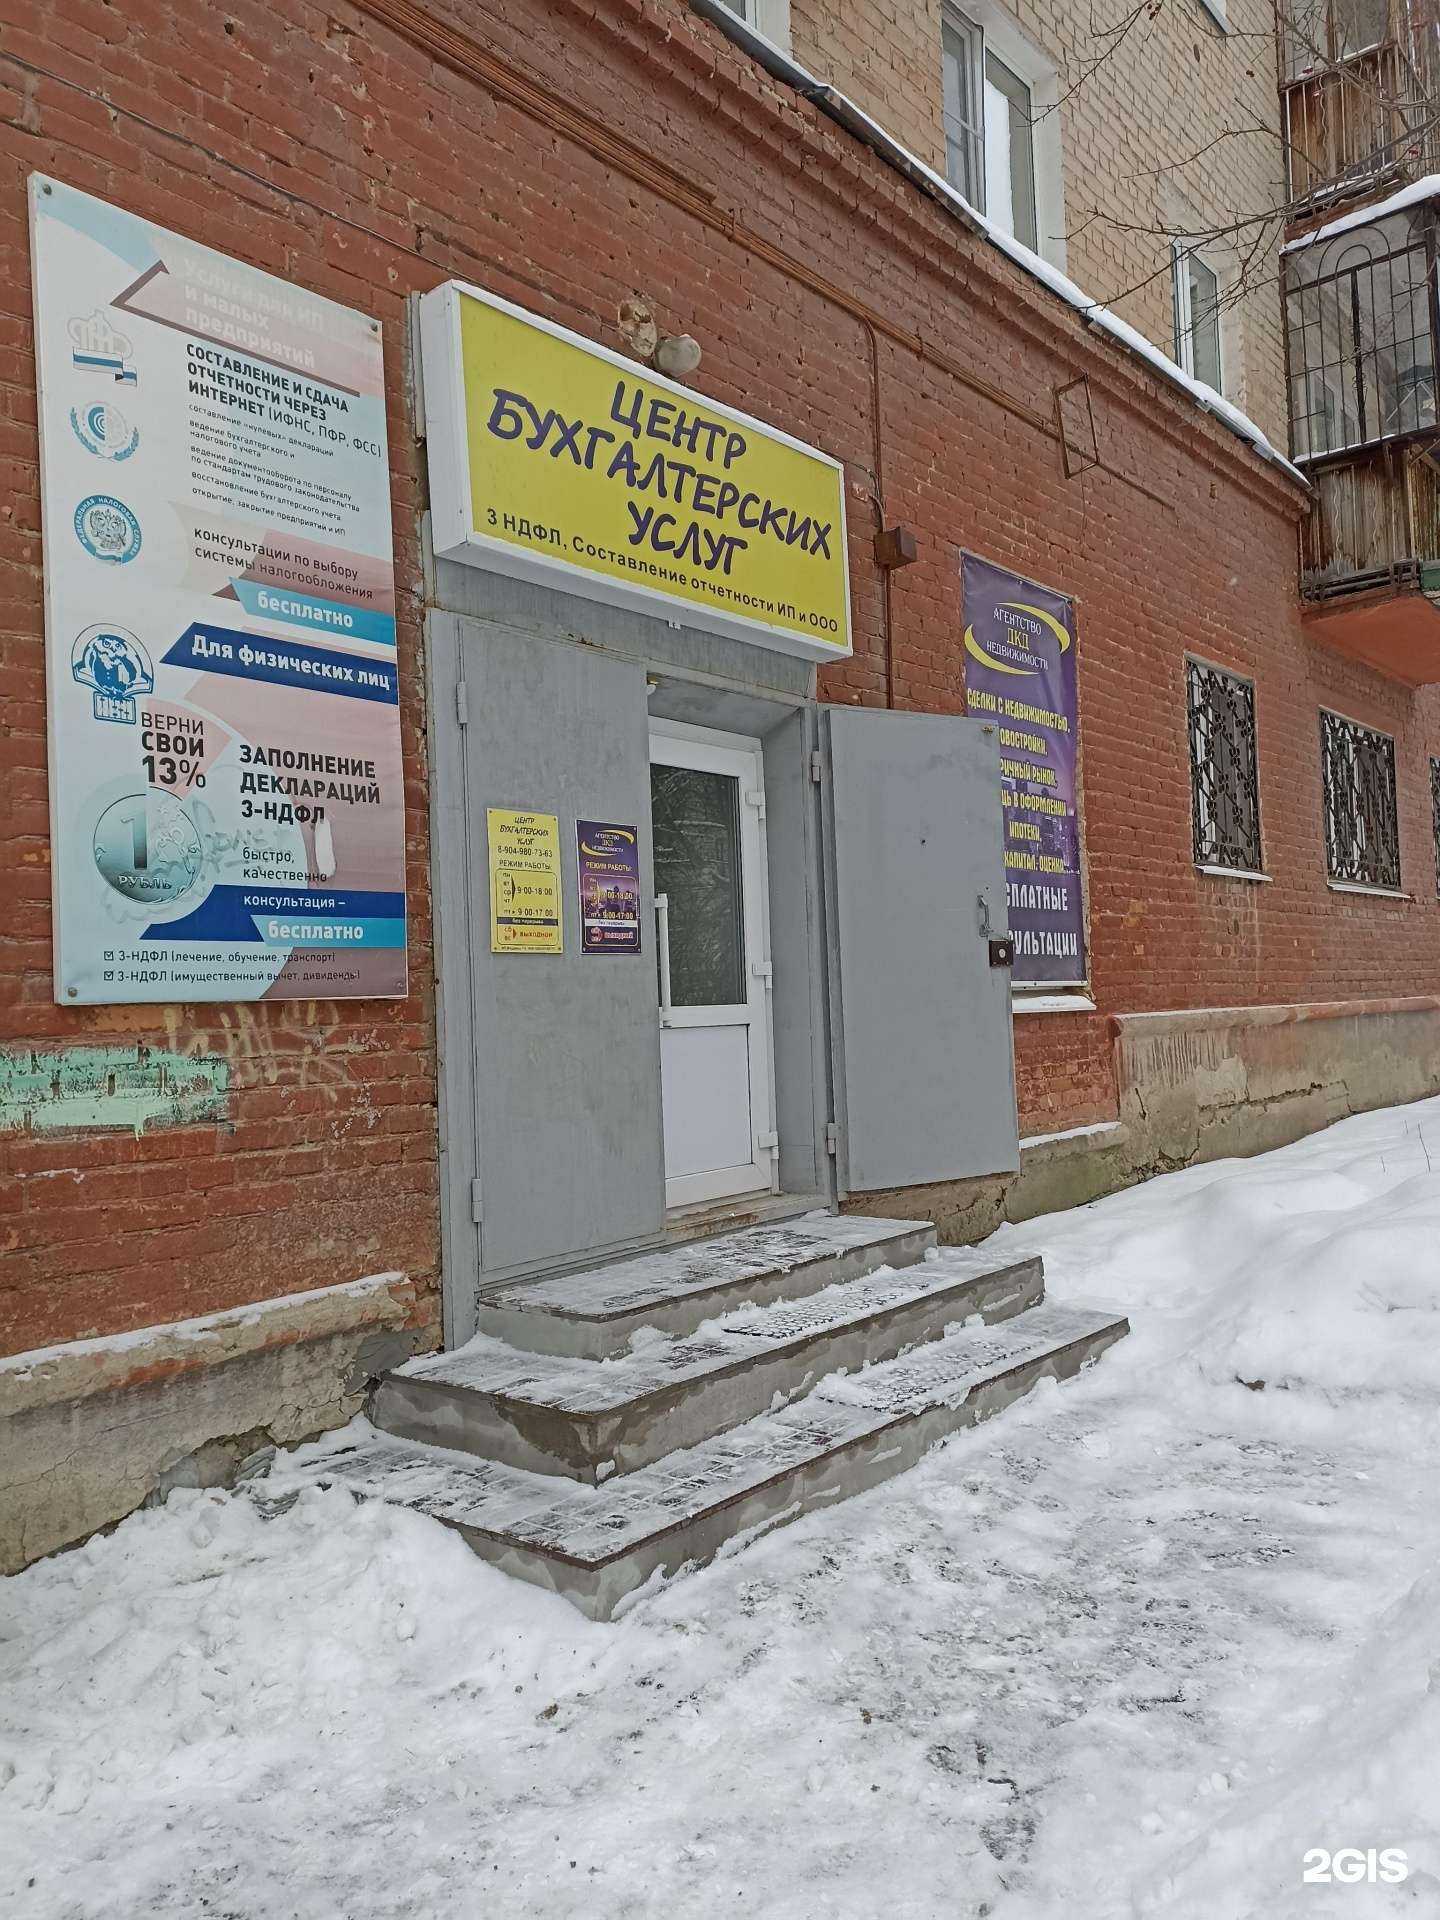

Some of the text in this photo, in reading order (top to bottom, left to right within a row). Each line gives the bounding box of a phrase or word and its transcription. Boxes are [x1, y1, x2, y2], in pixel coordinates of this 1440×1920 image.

[184, 284, 270, 331] и малых
[185, 306, 315, 369] предприятий
[186, 343, 349, 413] СОСТАВЛЕНИЕ И СДАЧА
[188, 362, 327, 421] ОТЧЕТНОСТИ ЧЕРЕЗ
[188, 380, 382, 457] ИНТЕРНЕТ (ИФНС, ПФР, ФСС)
[189, 404, 334, 457] составление «нулевых» деклараций
[610, 380, 747, 469] ЦЕНТР
[190, 420, 225, 437] ведение
[227, 431, 288, 458] бухгалтерского
[190, 430, 261, 458] налогового учета
[190, 445, 352, 501] ведение документооборота по персоналу
[191, 455, 360, 513] по стандартам трудового законодательства
[486, 388, 832, 560] БУХГАЛТЕРСКИХ
[192, 472, 341, 521] восстановление бухгалтерского учета
[192, 488, 234, 505] открытие,
[238, 500, 275, 517] закрытие
[335, 526, 346, 536] ИП
[627, 500, 749, 575] УСЛУГ
[194, 527, 358, 581] консультации по выбору
[194, 547, 373, 600] системы налогообложения
[487, 508, 498, 527] 3
[503, 511, 568, 550] НДФЛ,
[572, 535, 687, 587] Составление
[690, 575, 775, 612] отчетности
[777, 600, 796, 621] ИП
[810, 612, 839, 633] ООО
[257, 590, 354, 628] бесплатно
[993, 607, 1042, 636] АГЕНТСТВО
[1006, 627, 1030, 650] ДКД
[191, 634, 391, 691] Для физических лиц
[986, 640, 1049, 671] НЕДВИЖИМОСТИ
[967, 687, 997, 713] СДЕЛКИ
[998, 700, 1004, 715] С
[141, 712, 204, 736] ВЕРНИ
[141, 731, 204, 758] СВОИ
[1000, 727, 1048, 756] ОВОСТРОЙКИ.
[141, 755, 206, 789] 13%
[239, 744, 376, 779] ЗАПОЛНЕНИЕ
[240, 772, 381, 805] ДЕКЛАРАЦИЙ
[241, 799, 325, 825] 3-НДФЛ
[1013, 791, 1019, 808] В
[1020, 793, 1067, 817] ОФОРМЛЕНИИ
[499, 825, 549, 837] БУХГАЛТЕРСКИХ
[514, 816, 535, 824] ЦЕНТР
[120, 808, 148, 870] 1
[497, 845, 553, 858] 8-904-980-73-63
[243, 847, 295, 865] быстро,
[499, 859, 523, 868] РЕЖИМ
[585, 861, 607, 870] РЕЖИМ
[118, 874, 172, 889] РУБЛЬ
[243, 867, 328, 882] качественно
[243, 894, 336, 910] консультация
[517, 886, 553, 896] 9:00-18:00
[1006, 882, 1068, 911] СПЛАТНЫЕ
[517, 907, 553, 917] 9:00-17:00
[267, 920, 364, 940] бесплатно
[119, 950, 336, 965] 3-НДФЛ (лечение, обучение, транспорт)
[117, 971, 361, 984] 3-НДФЛ (имущественный вычет, дивиденды)
